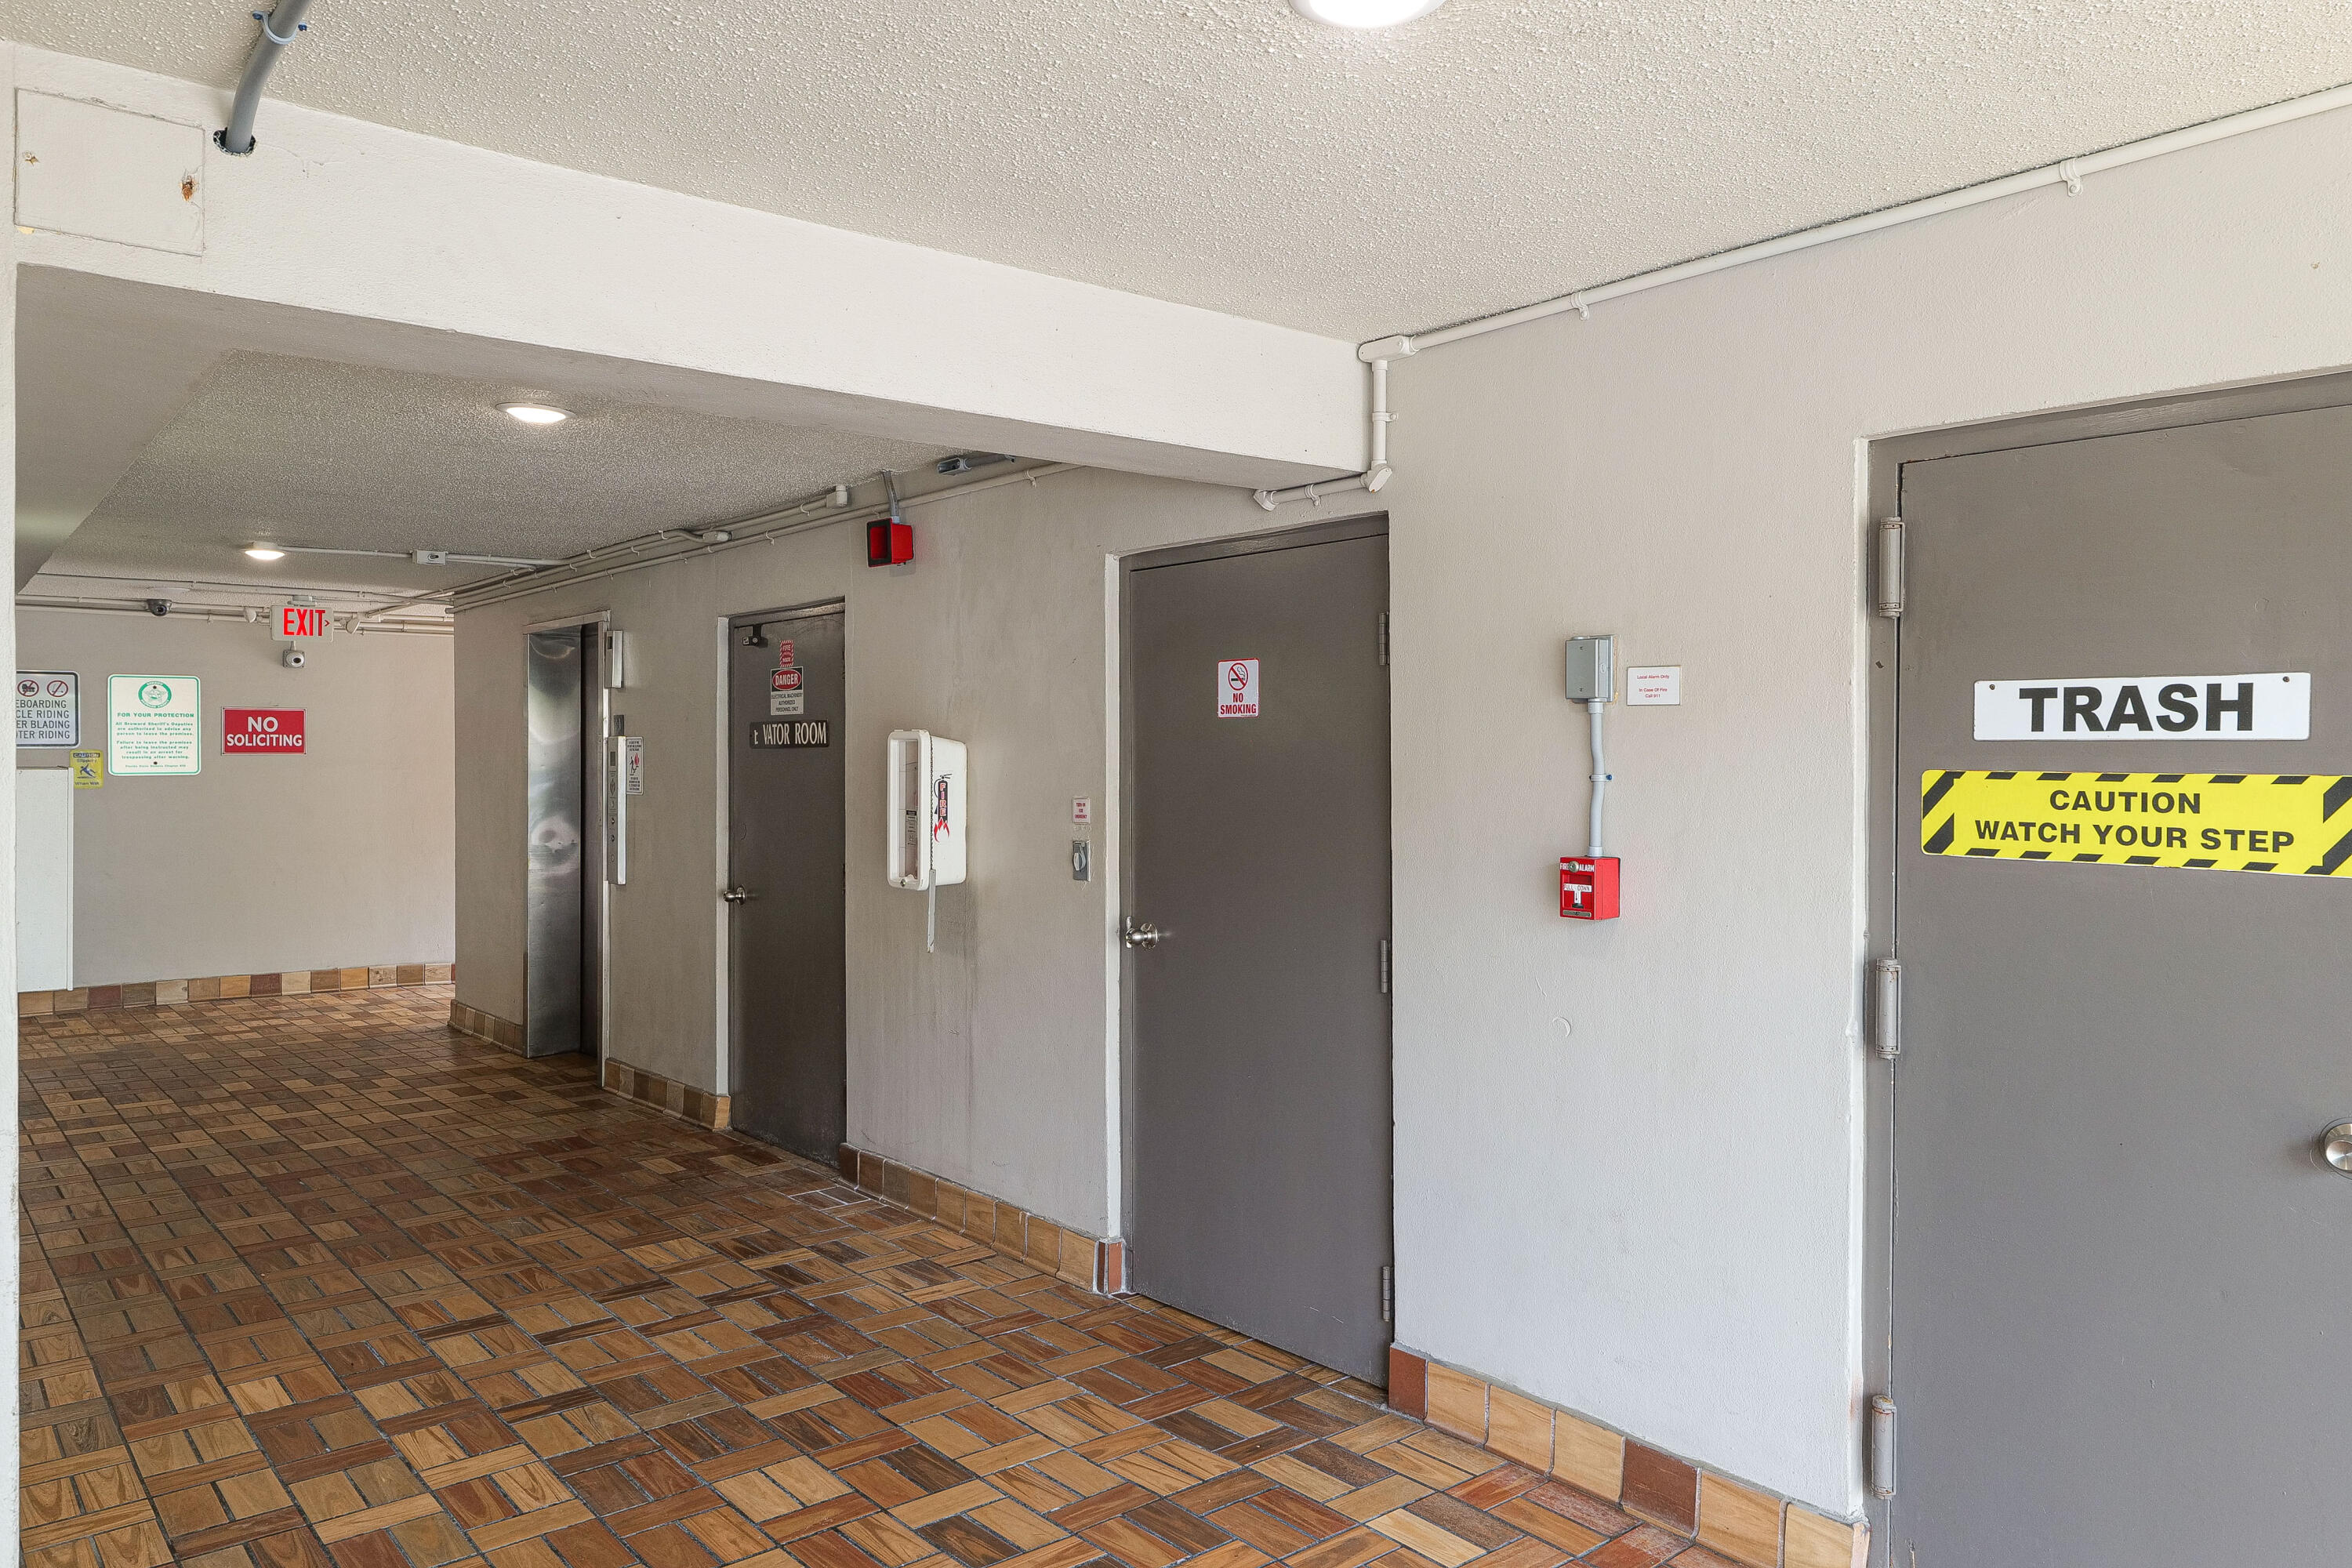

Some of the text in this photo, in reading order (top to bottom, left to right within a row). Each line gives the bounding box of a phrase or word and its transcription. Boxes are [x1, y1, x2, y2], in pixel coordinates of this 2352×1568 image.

[283, 608, 326, 637] EXIT
[775, 673, 798, 686] DANGER
[1232, 692, 1244, 702] NO
[1220, 704, 1256, 714] SMOKING
[2019, 682, 2255, 733] TRASH
[36, 710, 70, 719] RIDING
[31, 720, 71, 729] BLADING
[248, 716, 278, 732] NO
[38, 730, 71, 739] RIDING
[795, 722, 827, 745] ROOM
[227, 734, 303, 747] SOLICITING
[2049, 789, 2201, 815] CAUTION
[1974, 819, 2295, 854] WATCH YOUR STEP
[1579, 863, 1595, 872] ALARM
